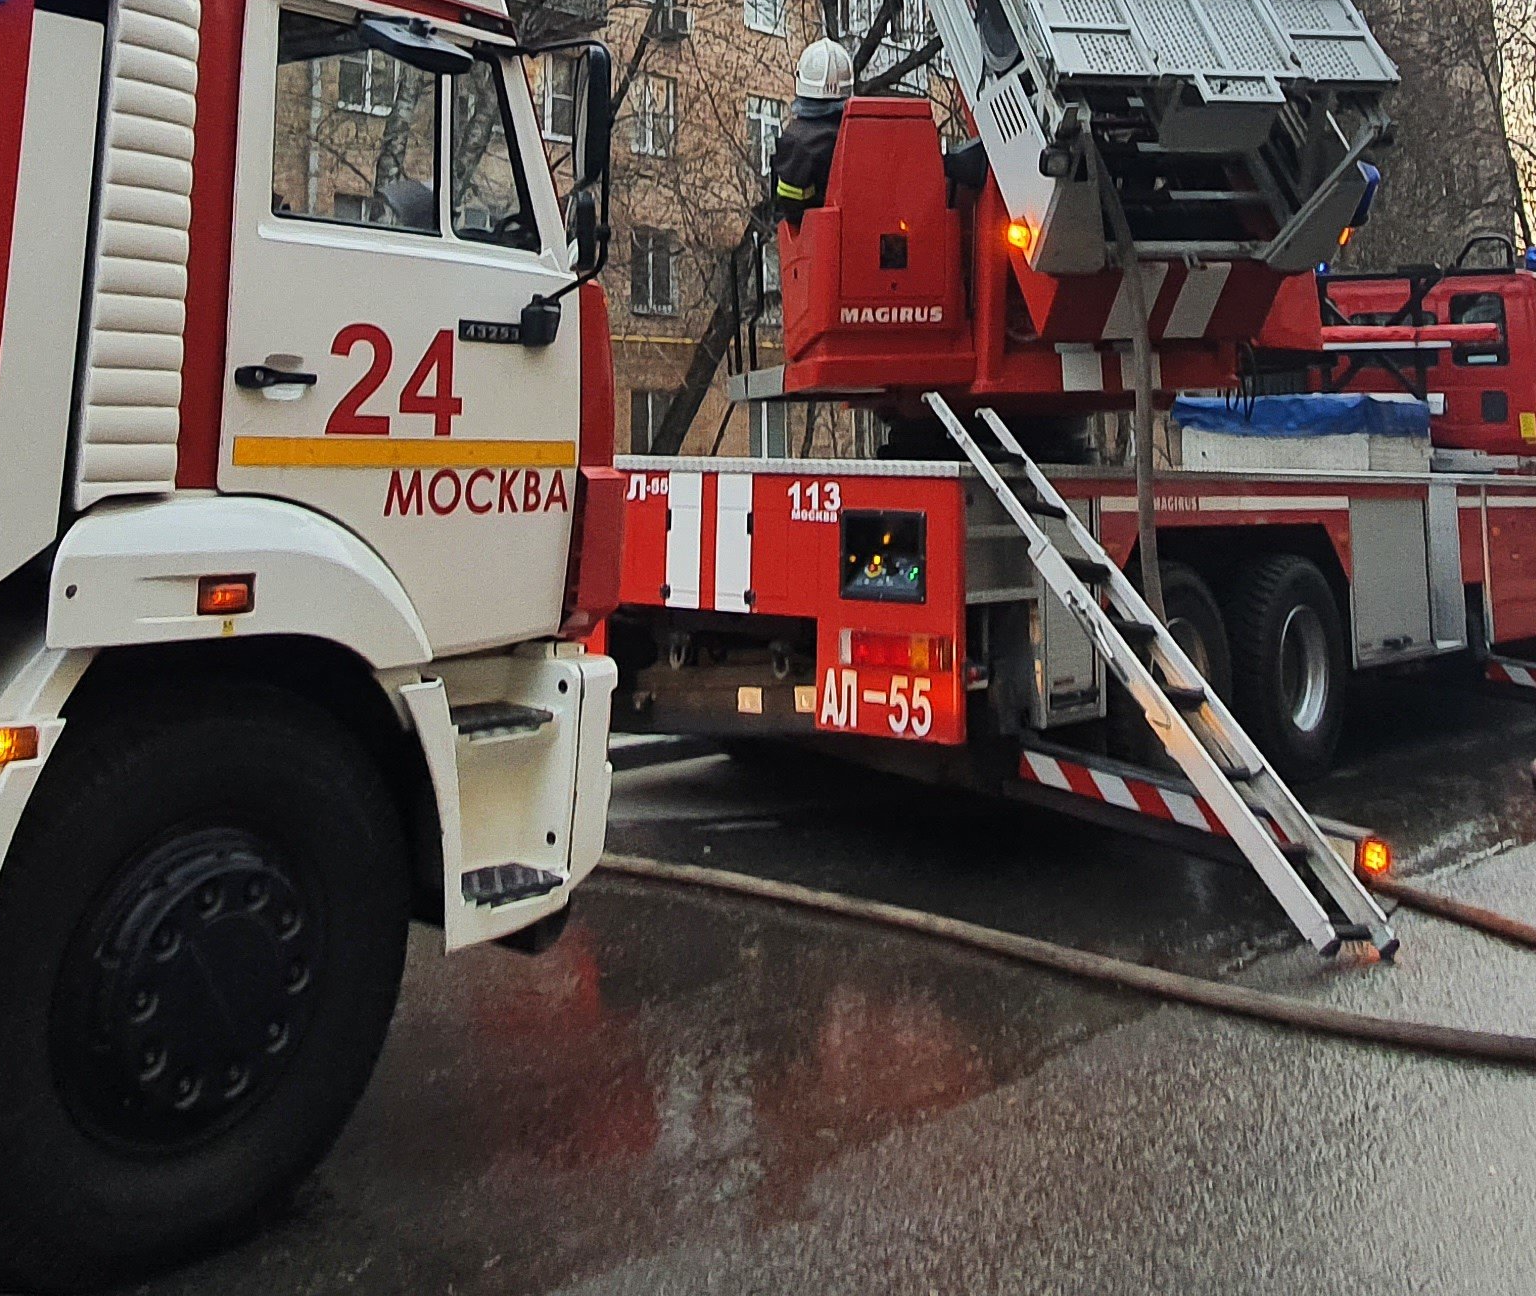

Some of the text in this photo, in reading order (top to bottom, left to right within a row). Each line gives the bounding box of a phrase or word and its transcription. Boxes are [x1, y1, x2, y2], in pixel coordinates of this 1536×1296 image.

[840, 305, 943, 324] MAGIRUS
[324, 322, 463, 437] 24
[382, 467, 568, 517] МОСКВА
[787, 480, 841, 512] 113
[820, 667, 932, 737] АЛ-55
